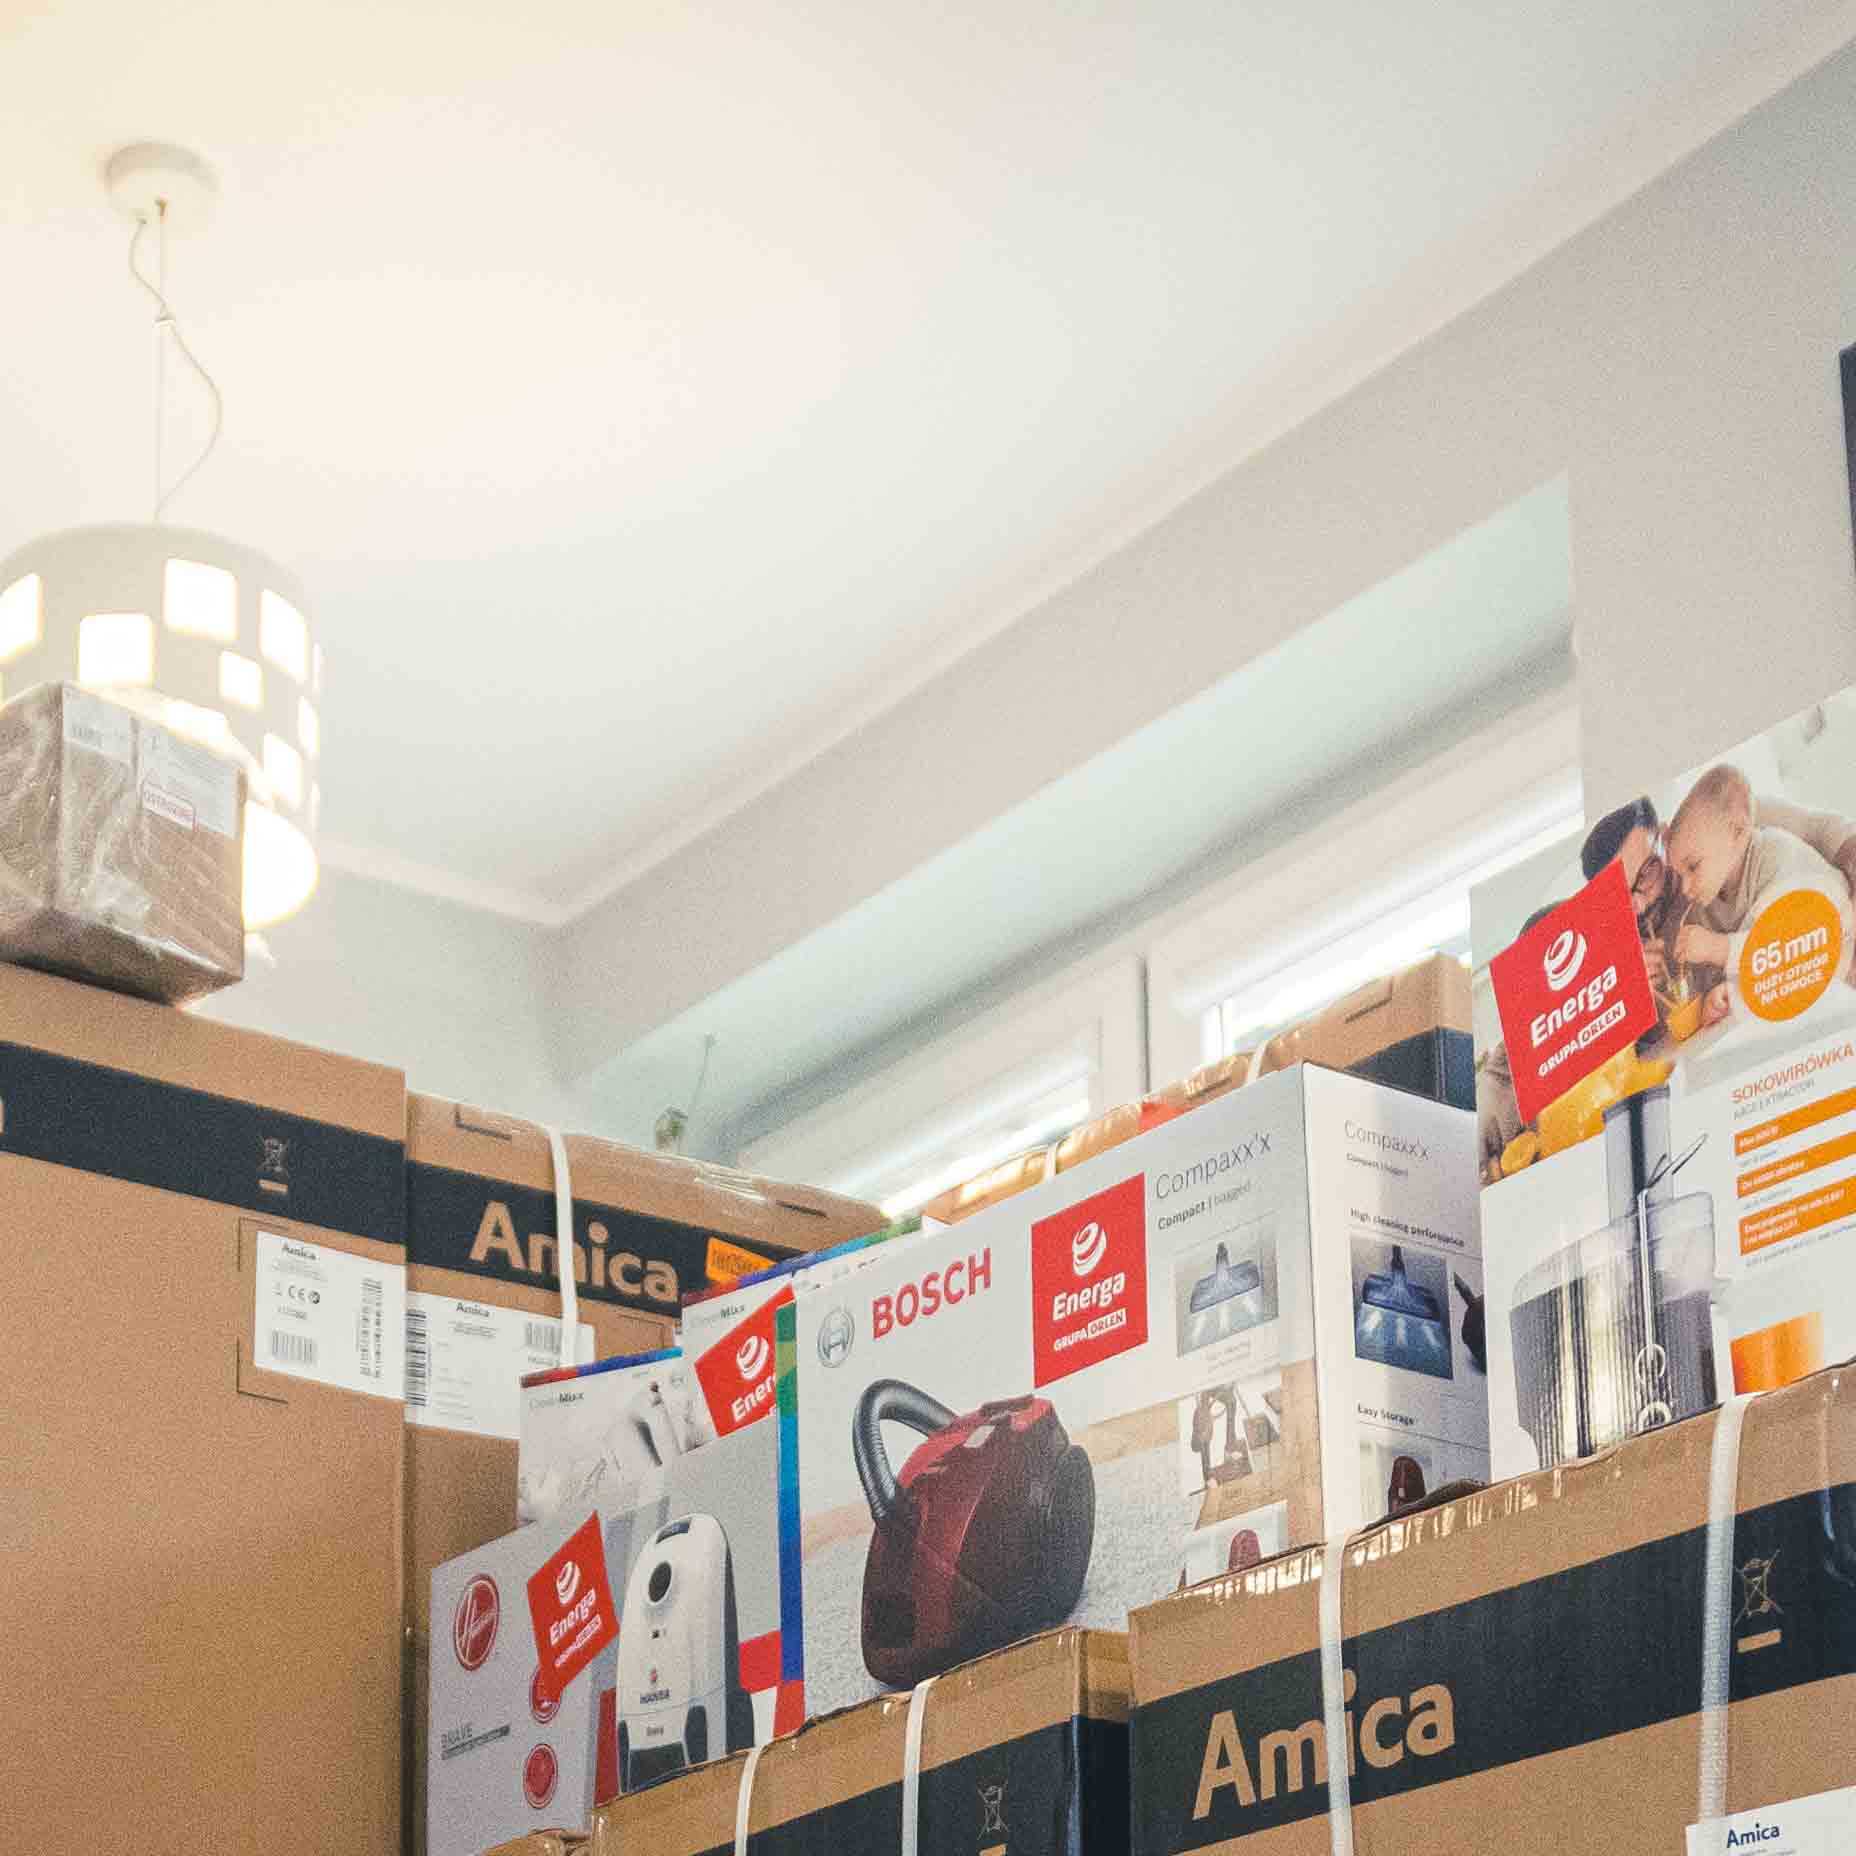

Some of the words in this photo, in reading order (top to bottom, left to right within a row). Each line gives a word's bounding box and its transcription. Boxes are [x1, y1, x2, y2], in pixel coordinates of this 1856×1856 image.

[1752, 940, 1783, 976] 65
[1785, 927, 1828, 962] mm
[1531, 965, 1617, 1049] Energa
[1537, 1039, 1578, 1078] GRUPA
[1580, 1003, 1624, 1044] ORLEN
[1157, 1201, 1206, 1231] Compact
[471, 1202, 680, 1304] Amica
[873, 1247, 992, 1340] BOSCH
[1053, 1272, 1126, 1321] Energa
[1053, 1327, 1088, 1352] GRUPA
[1089, 1310, 1125, 1337] ORLEN
[730, 1374, 777, 1423] Ener
[548, 1587, 597, 1646] Energa
[1726, 1822, 1780, 1849] Amica
